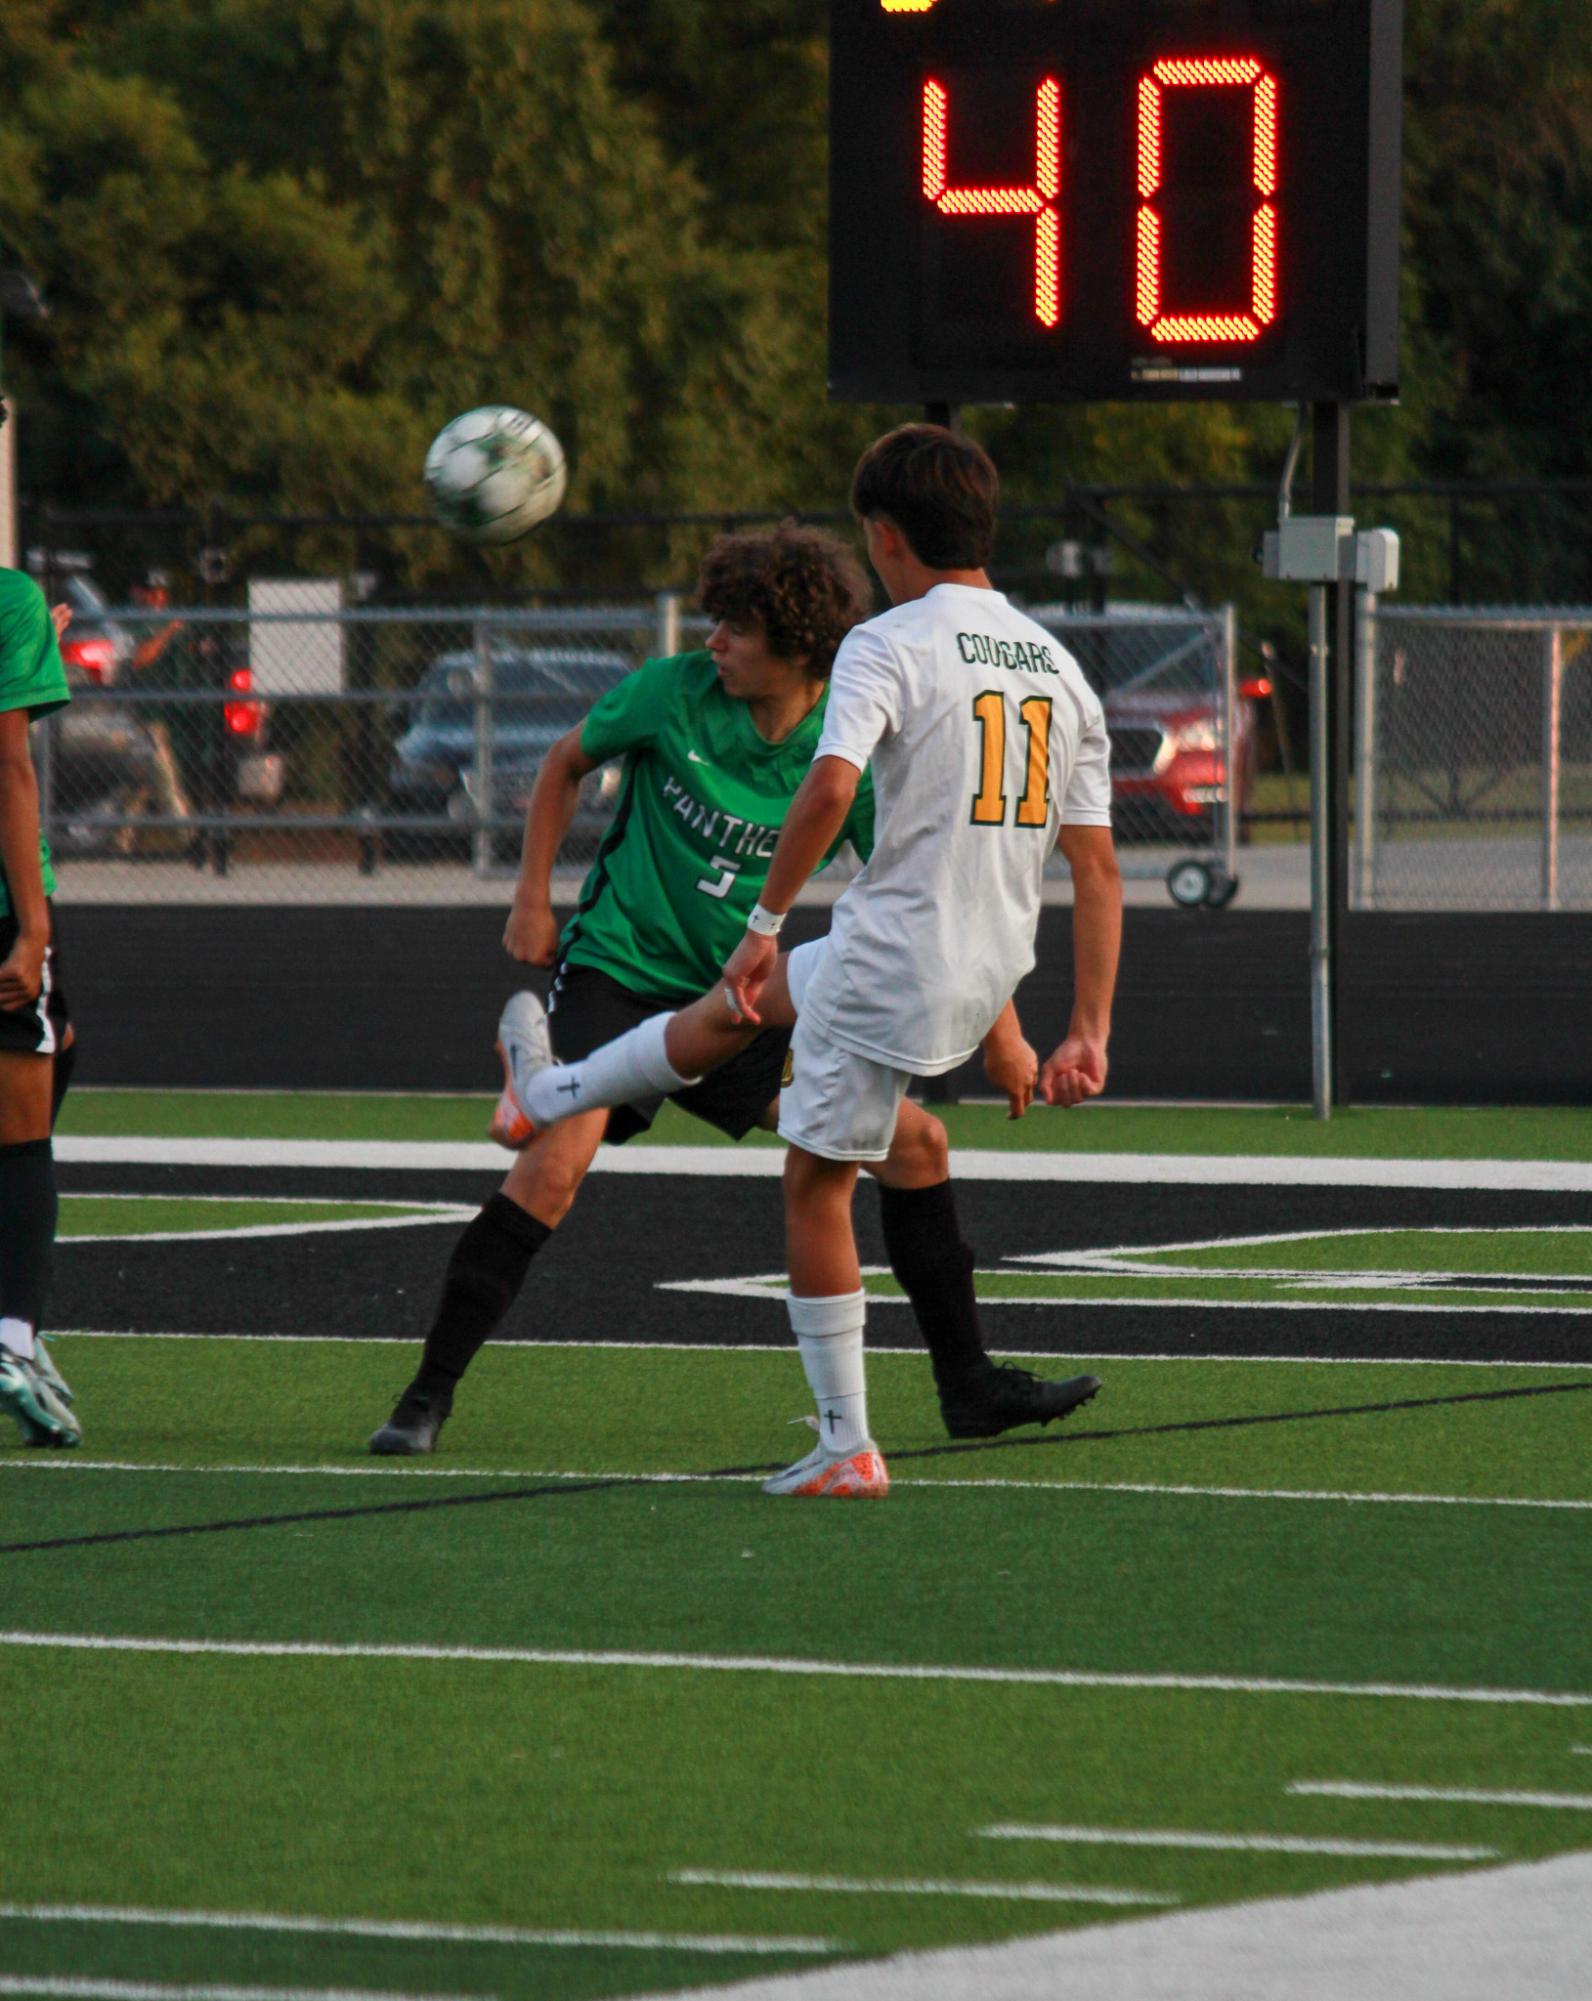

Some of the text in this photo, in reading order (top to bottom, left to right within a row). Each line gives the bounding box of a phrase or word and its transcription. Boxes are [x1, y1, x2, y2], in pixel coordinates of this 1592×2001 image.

[922, 57, 1278, 344] 40
[956, 632, 1060, 675] COUGARS
[969, 690, 1053, 829] 11
[663, 776, 780, 858] PANTHE
[696, 855, 741, 898] 5
